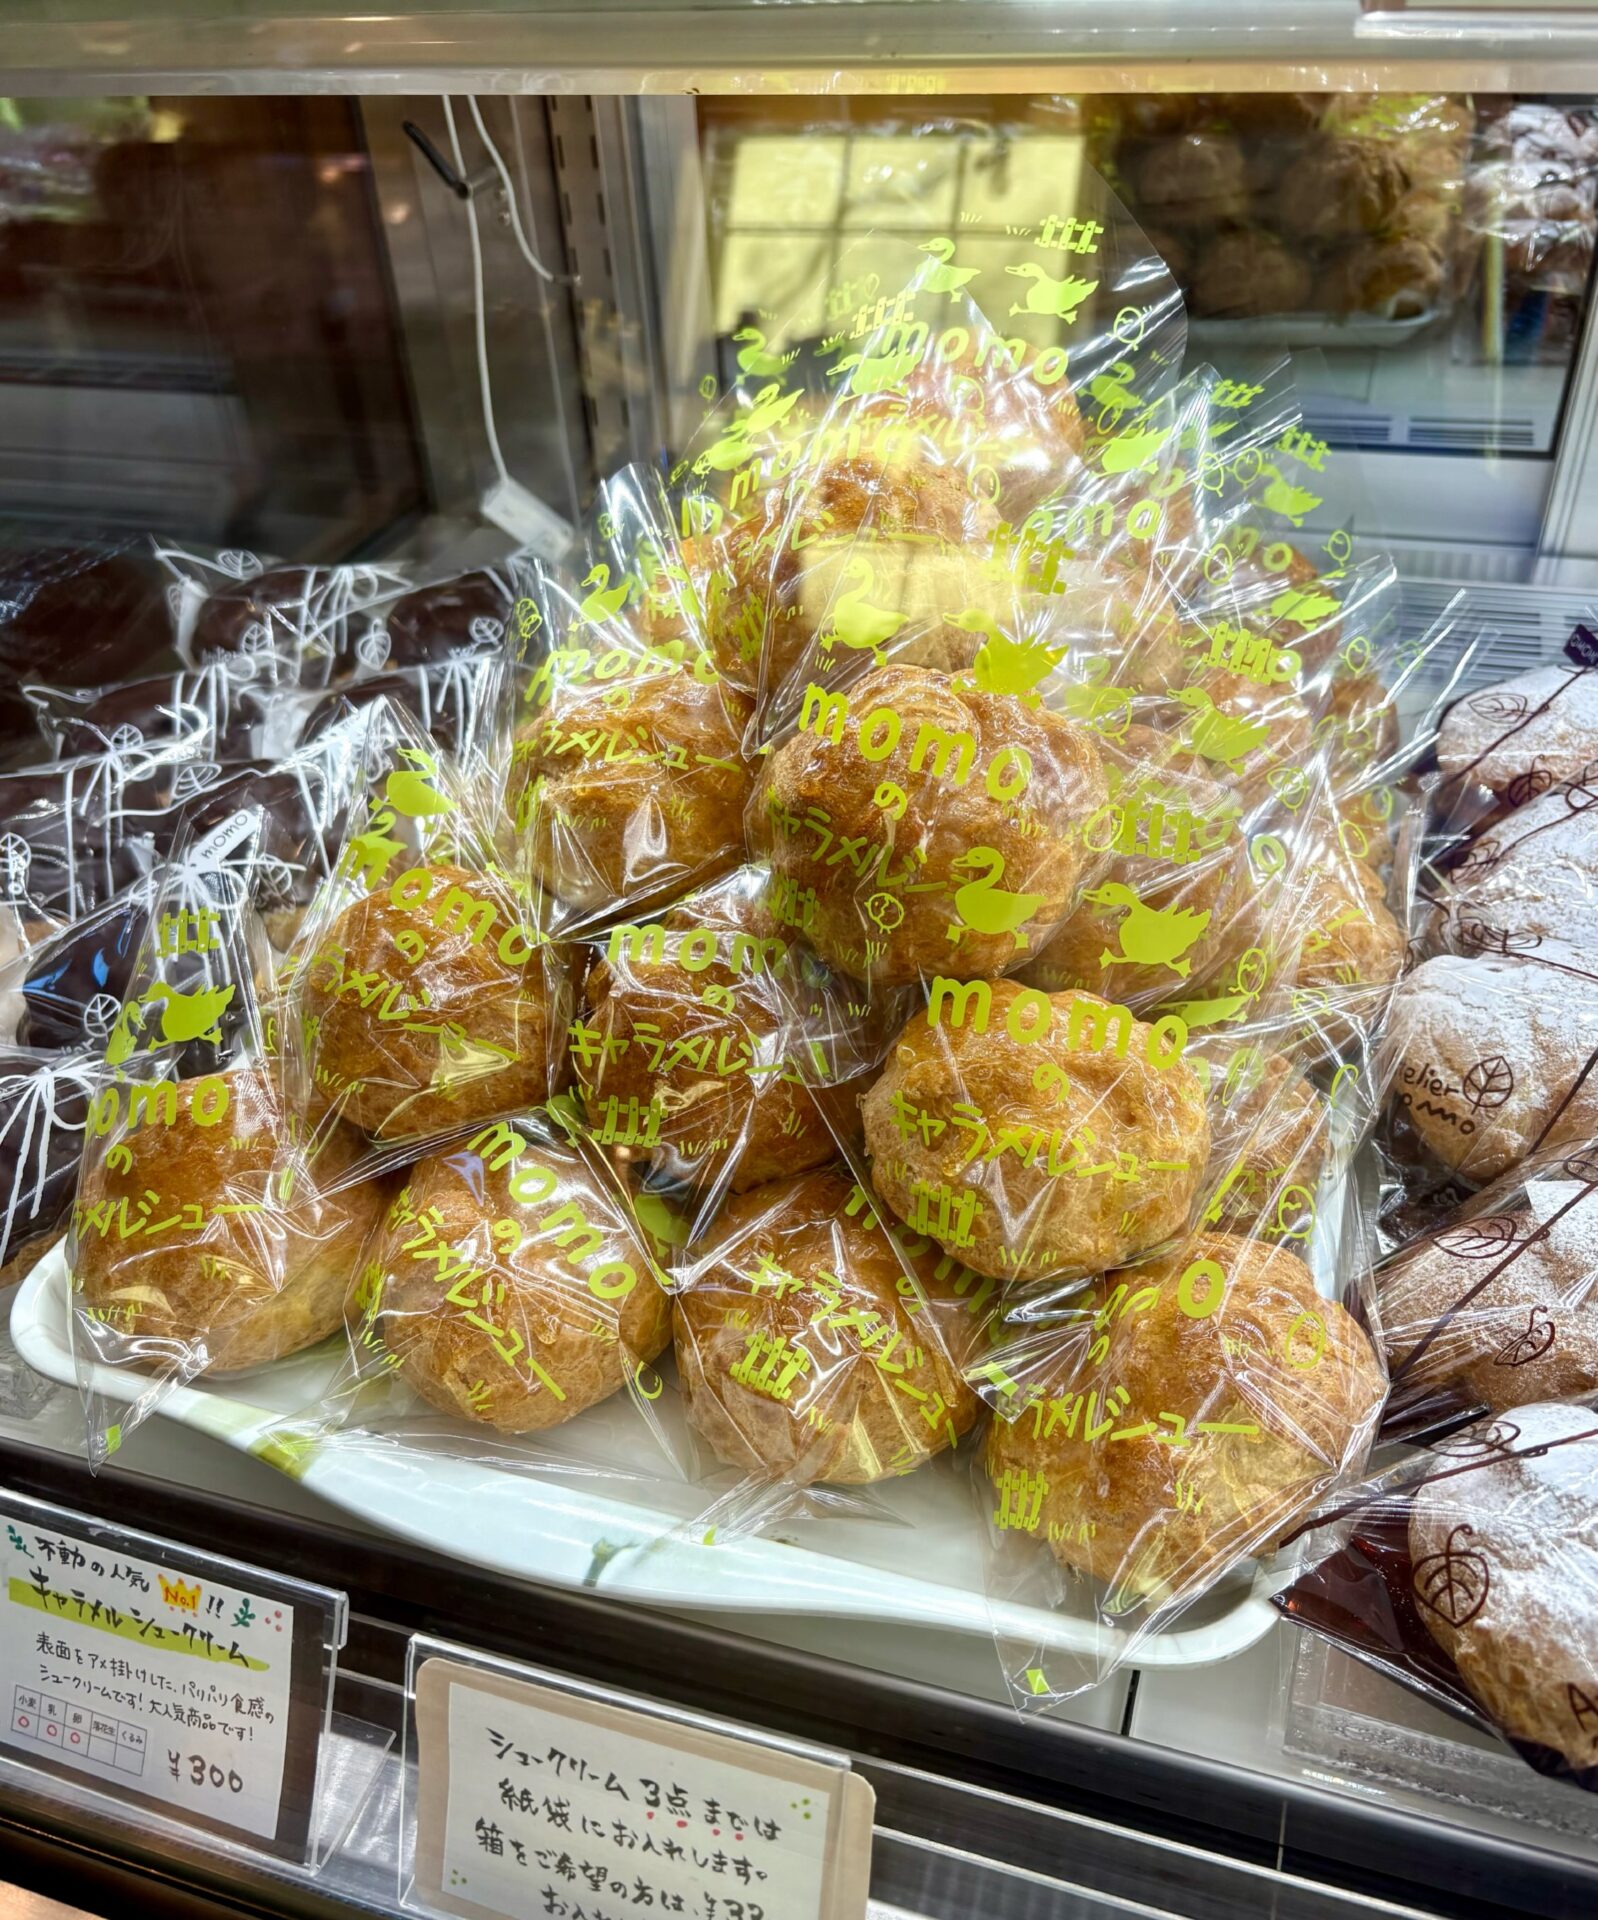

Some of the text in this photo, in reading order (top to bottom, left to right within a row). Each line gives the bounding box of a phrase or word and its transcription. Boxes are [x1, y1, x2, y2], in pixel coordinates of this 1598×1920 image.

[799, 682, 1033, 801] momo
[873, 782, 908, 821] の
[339, 844, 534, 966] momo
[394, 929, 426, 965] の
[607, 924, 788, 980] mom
[701, 983, 736, 1015] の
[927, 975, 1189, 1070] momo
[92, 1077, 230, 1137] omo
[1032, 1063, 1069, 1102] の
[106, 1143, 133, 1176] の
[890, 1090, 1191, 1182] キャラメルシュー
[466, 1121, 638, 1300] momo
[492, 1218, 523, 1254] の
[35, 1536, 150, 1593] 不動の人気
[168, 1749, 244, 1793] ¥300
